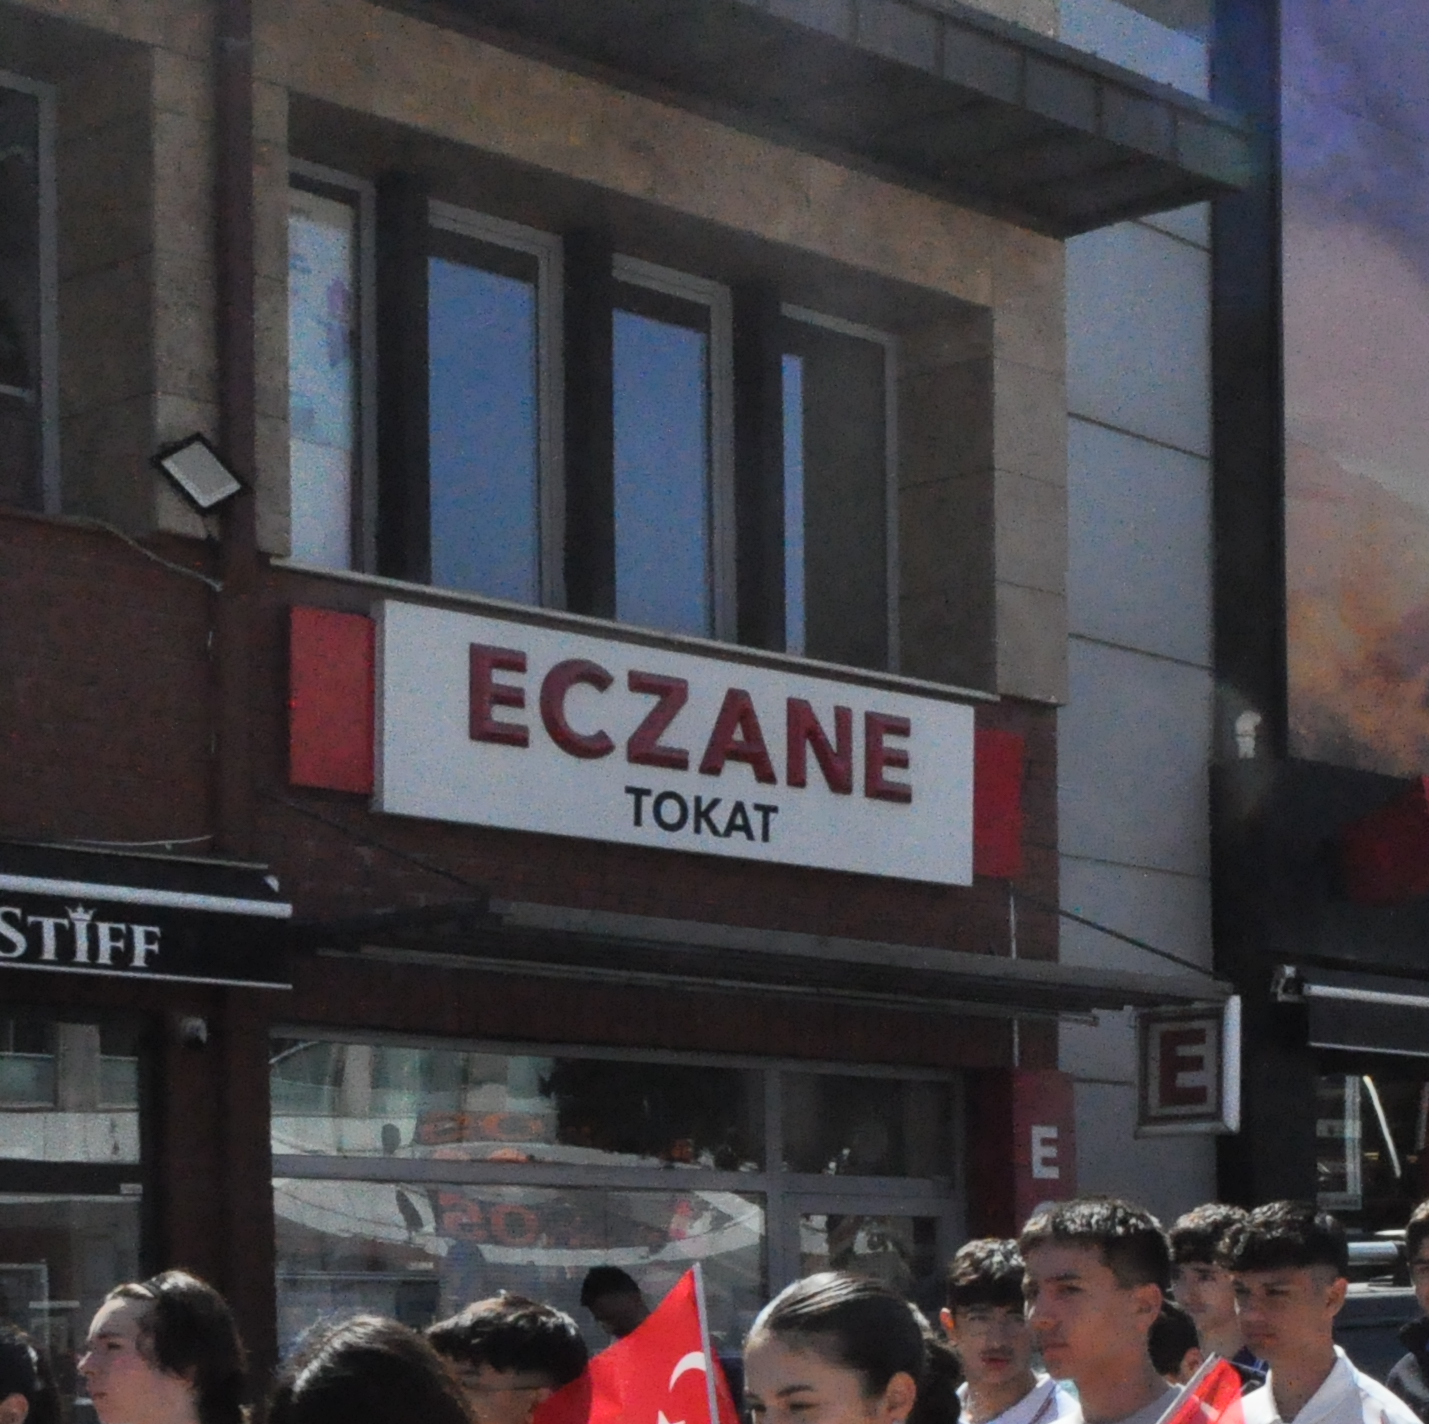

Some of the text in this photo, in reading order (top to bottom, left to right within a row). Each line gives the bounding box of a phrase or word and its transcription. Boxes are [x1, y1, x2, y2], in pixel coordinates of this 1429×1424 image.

[468, 642, 912, 804] ECZANE
[625, 785, 779, 843] TOKAT
[1159, 1029, 1208, 1110] E
[1032, 1126, 1059, 1179] E
